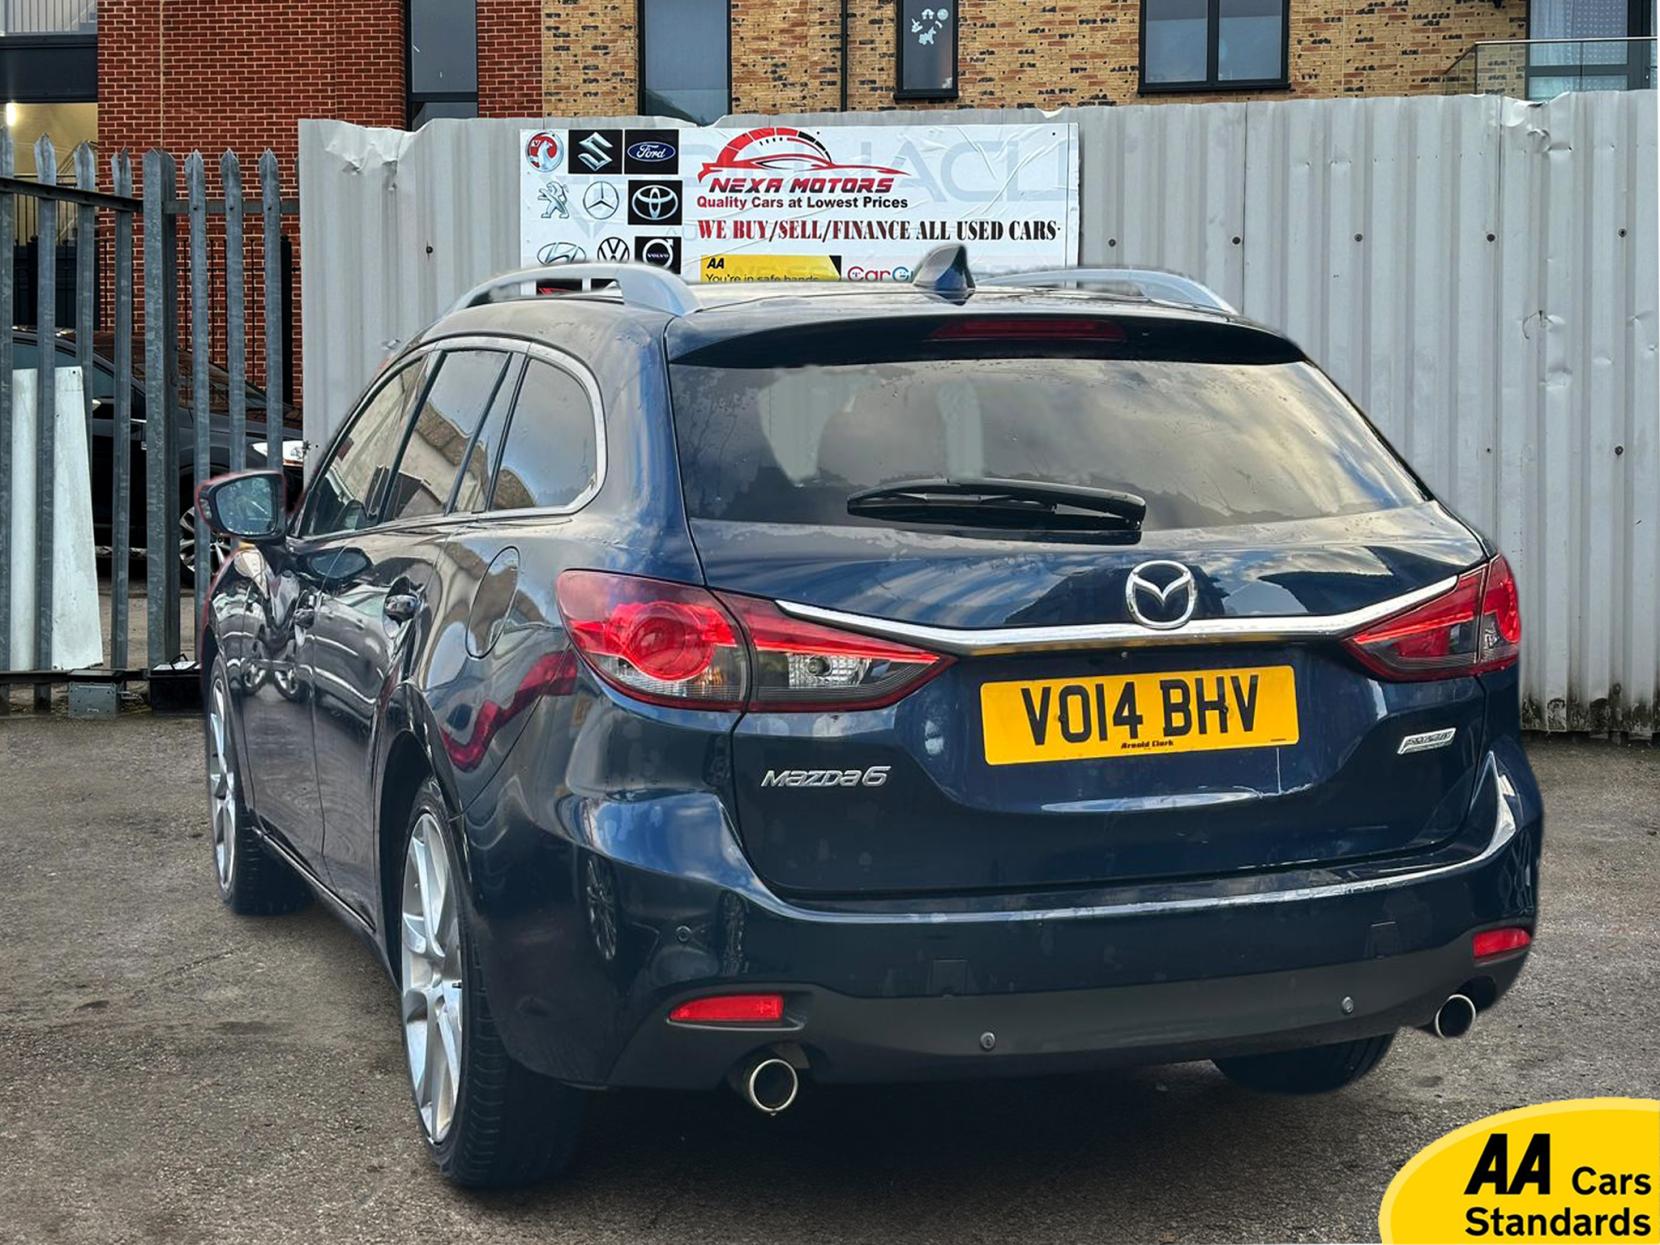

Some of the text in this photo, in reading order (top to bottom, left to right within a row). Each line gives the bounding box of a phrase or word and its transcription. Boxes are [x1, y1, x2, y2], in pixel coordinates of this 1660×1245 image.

[636, 143, 666, 159] Ford
[708, 177, 894, 193] NEXA MOTORS
[697, 195, 908, 210] Quality Cars at Lowest Prices
[698, 220, 727, 239] WE
[916, 220, 950, 240] ALL
[956, 220, 1004, 240] USED
[1008, 220, 1057, 240] CARS
[706, 257, 725, 269] AA
[1021, 674, 1260, 746] VO14 BHV
